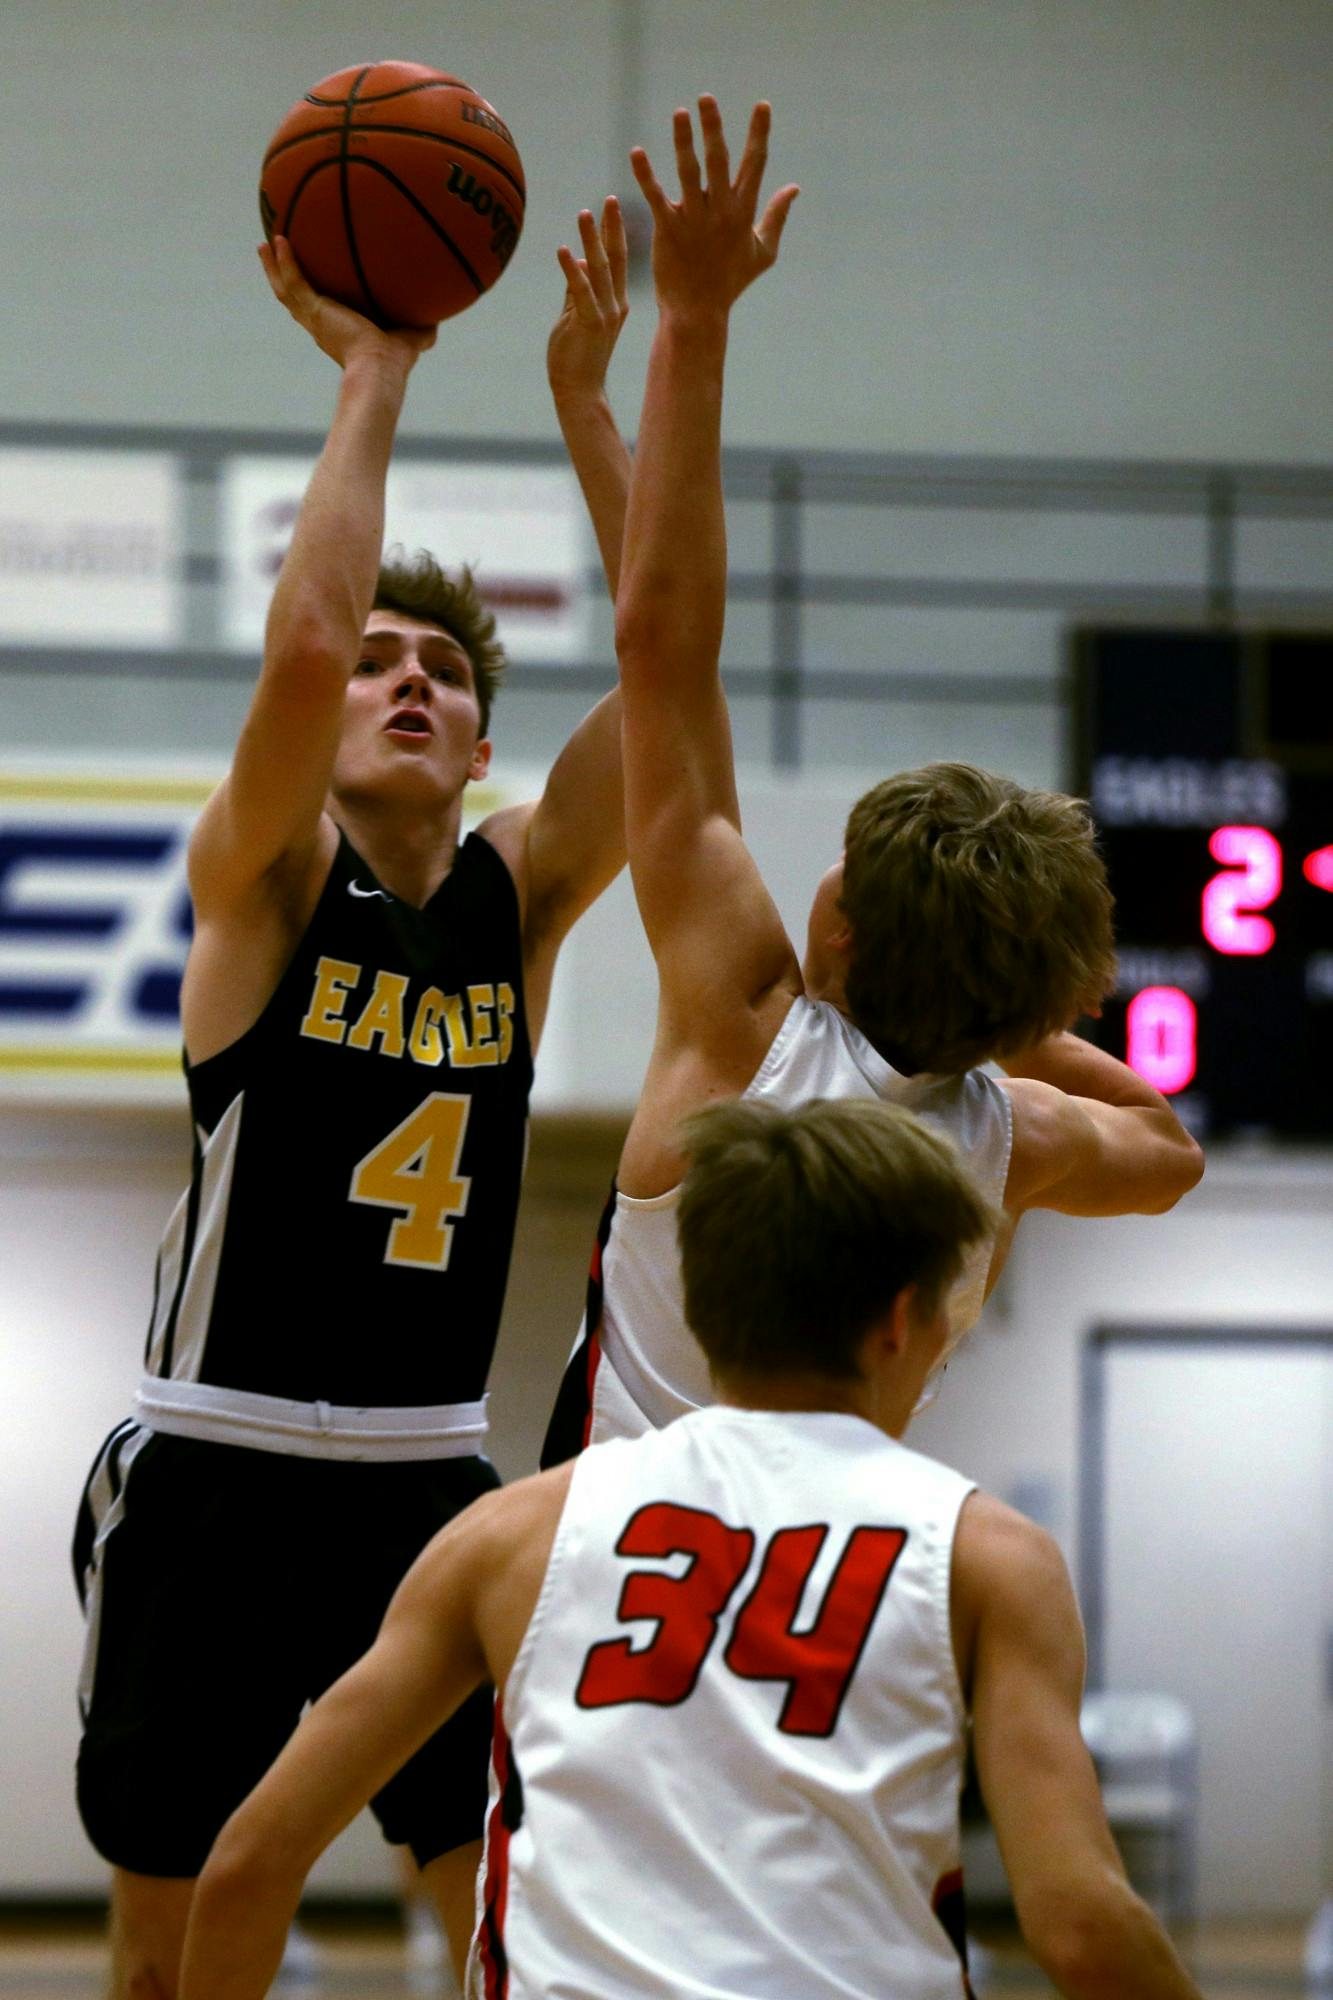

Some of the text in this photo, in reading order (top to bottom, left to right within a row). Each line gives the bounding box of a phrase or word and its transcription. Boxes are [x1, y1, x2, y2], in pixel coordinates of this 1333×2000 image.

[1202, 825, 1282, 956] 2
[299, 956, 515, 1068] EAGLES
[347, 1091, 472, 1272] 4
[575, 1501, 908, 1738] 34
